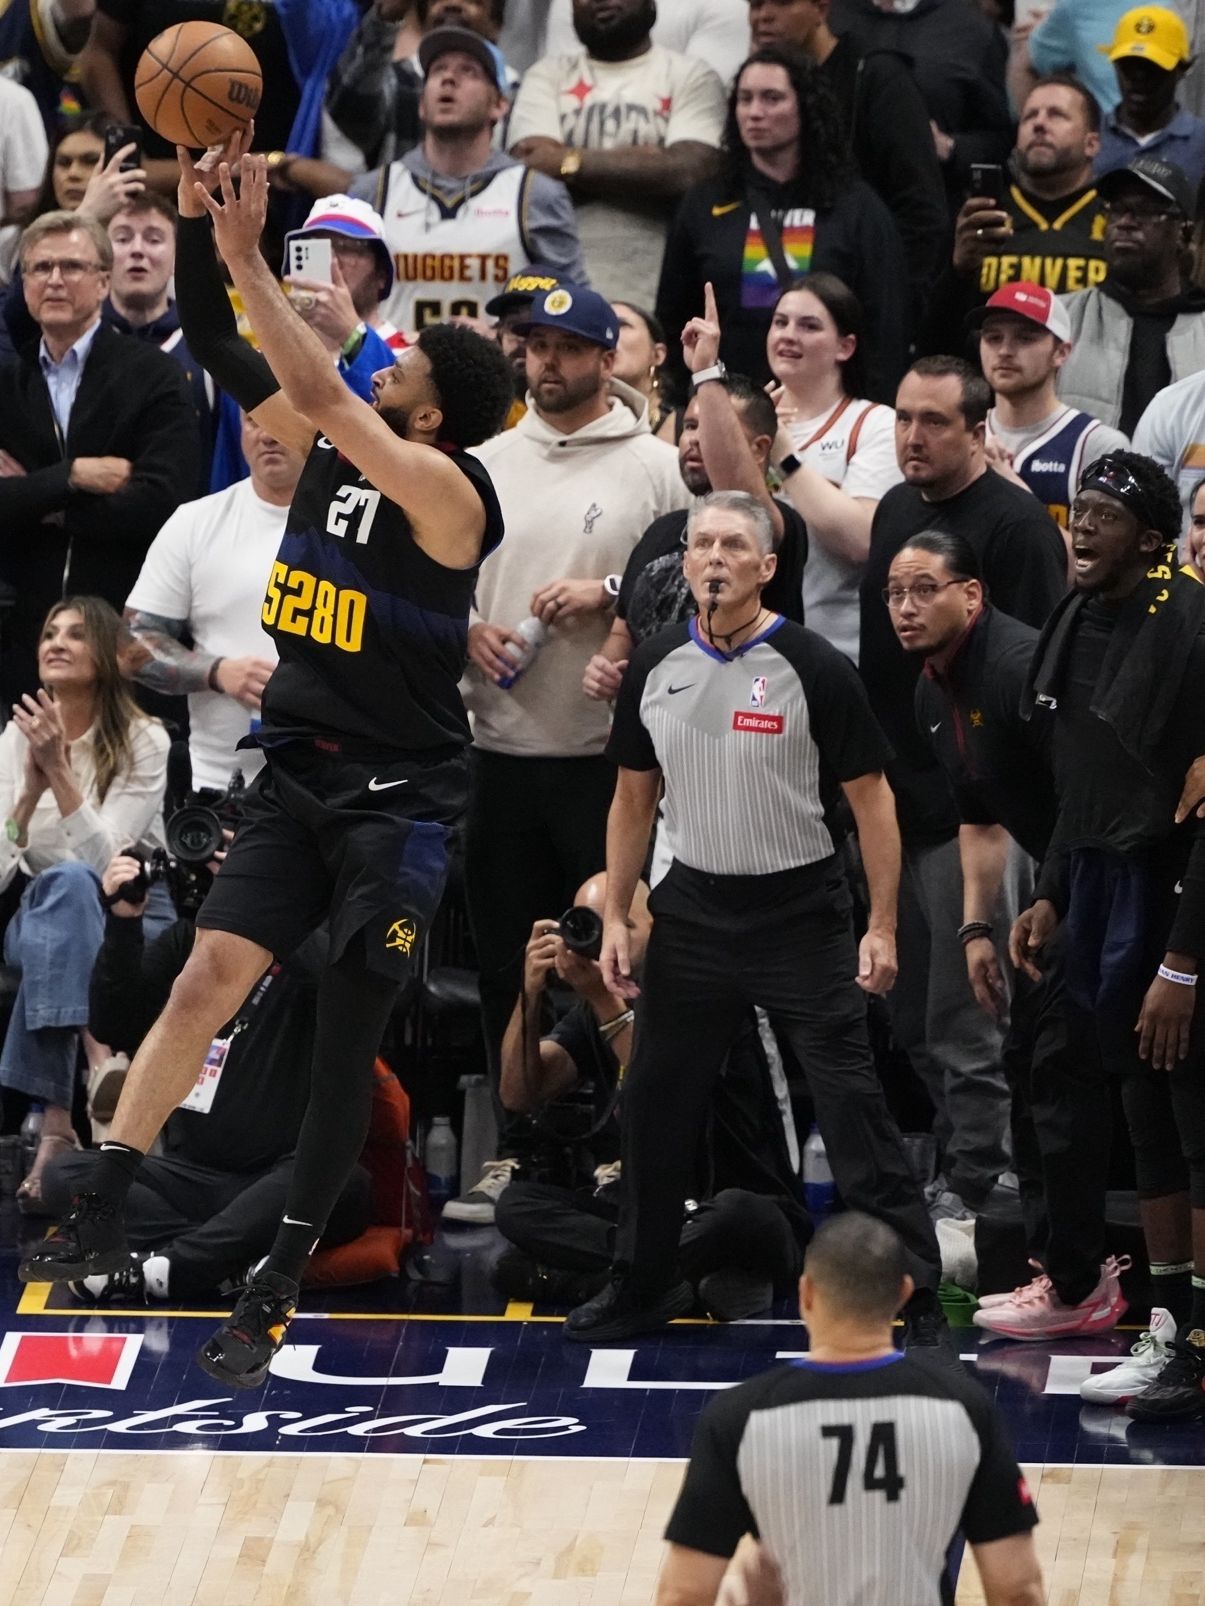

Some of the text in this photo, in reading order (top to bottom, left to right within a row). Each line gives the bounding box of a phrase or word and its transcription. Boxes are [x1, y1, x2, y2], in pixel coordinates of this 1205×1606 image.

[980, 255, 1108, 291] DENVER
[820, 439, 845, 451] WU
[326, 485, 381, 545] 27
[261, 560, 367, 653] 5280
[737, 715, 779, 730] Emirates
[821, 1421, 905, 1505] 74
